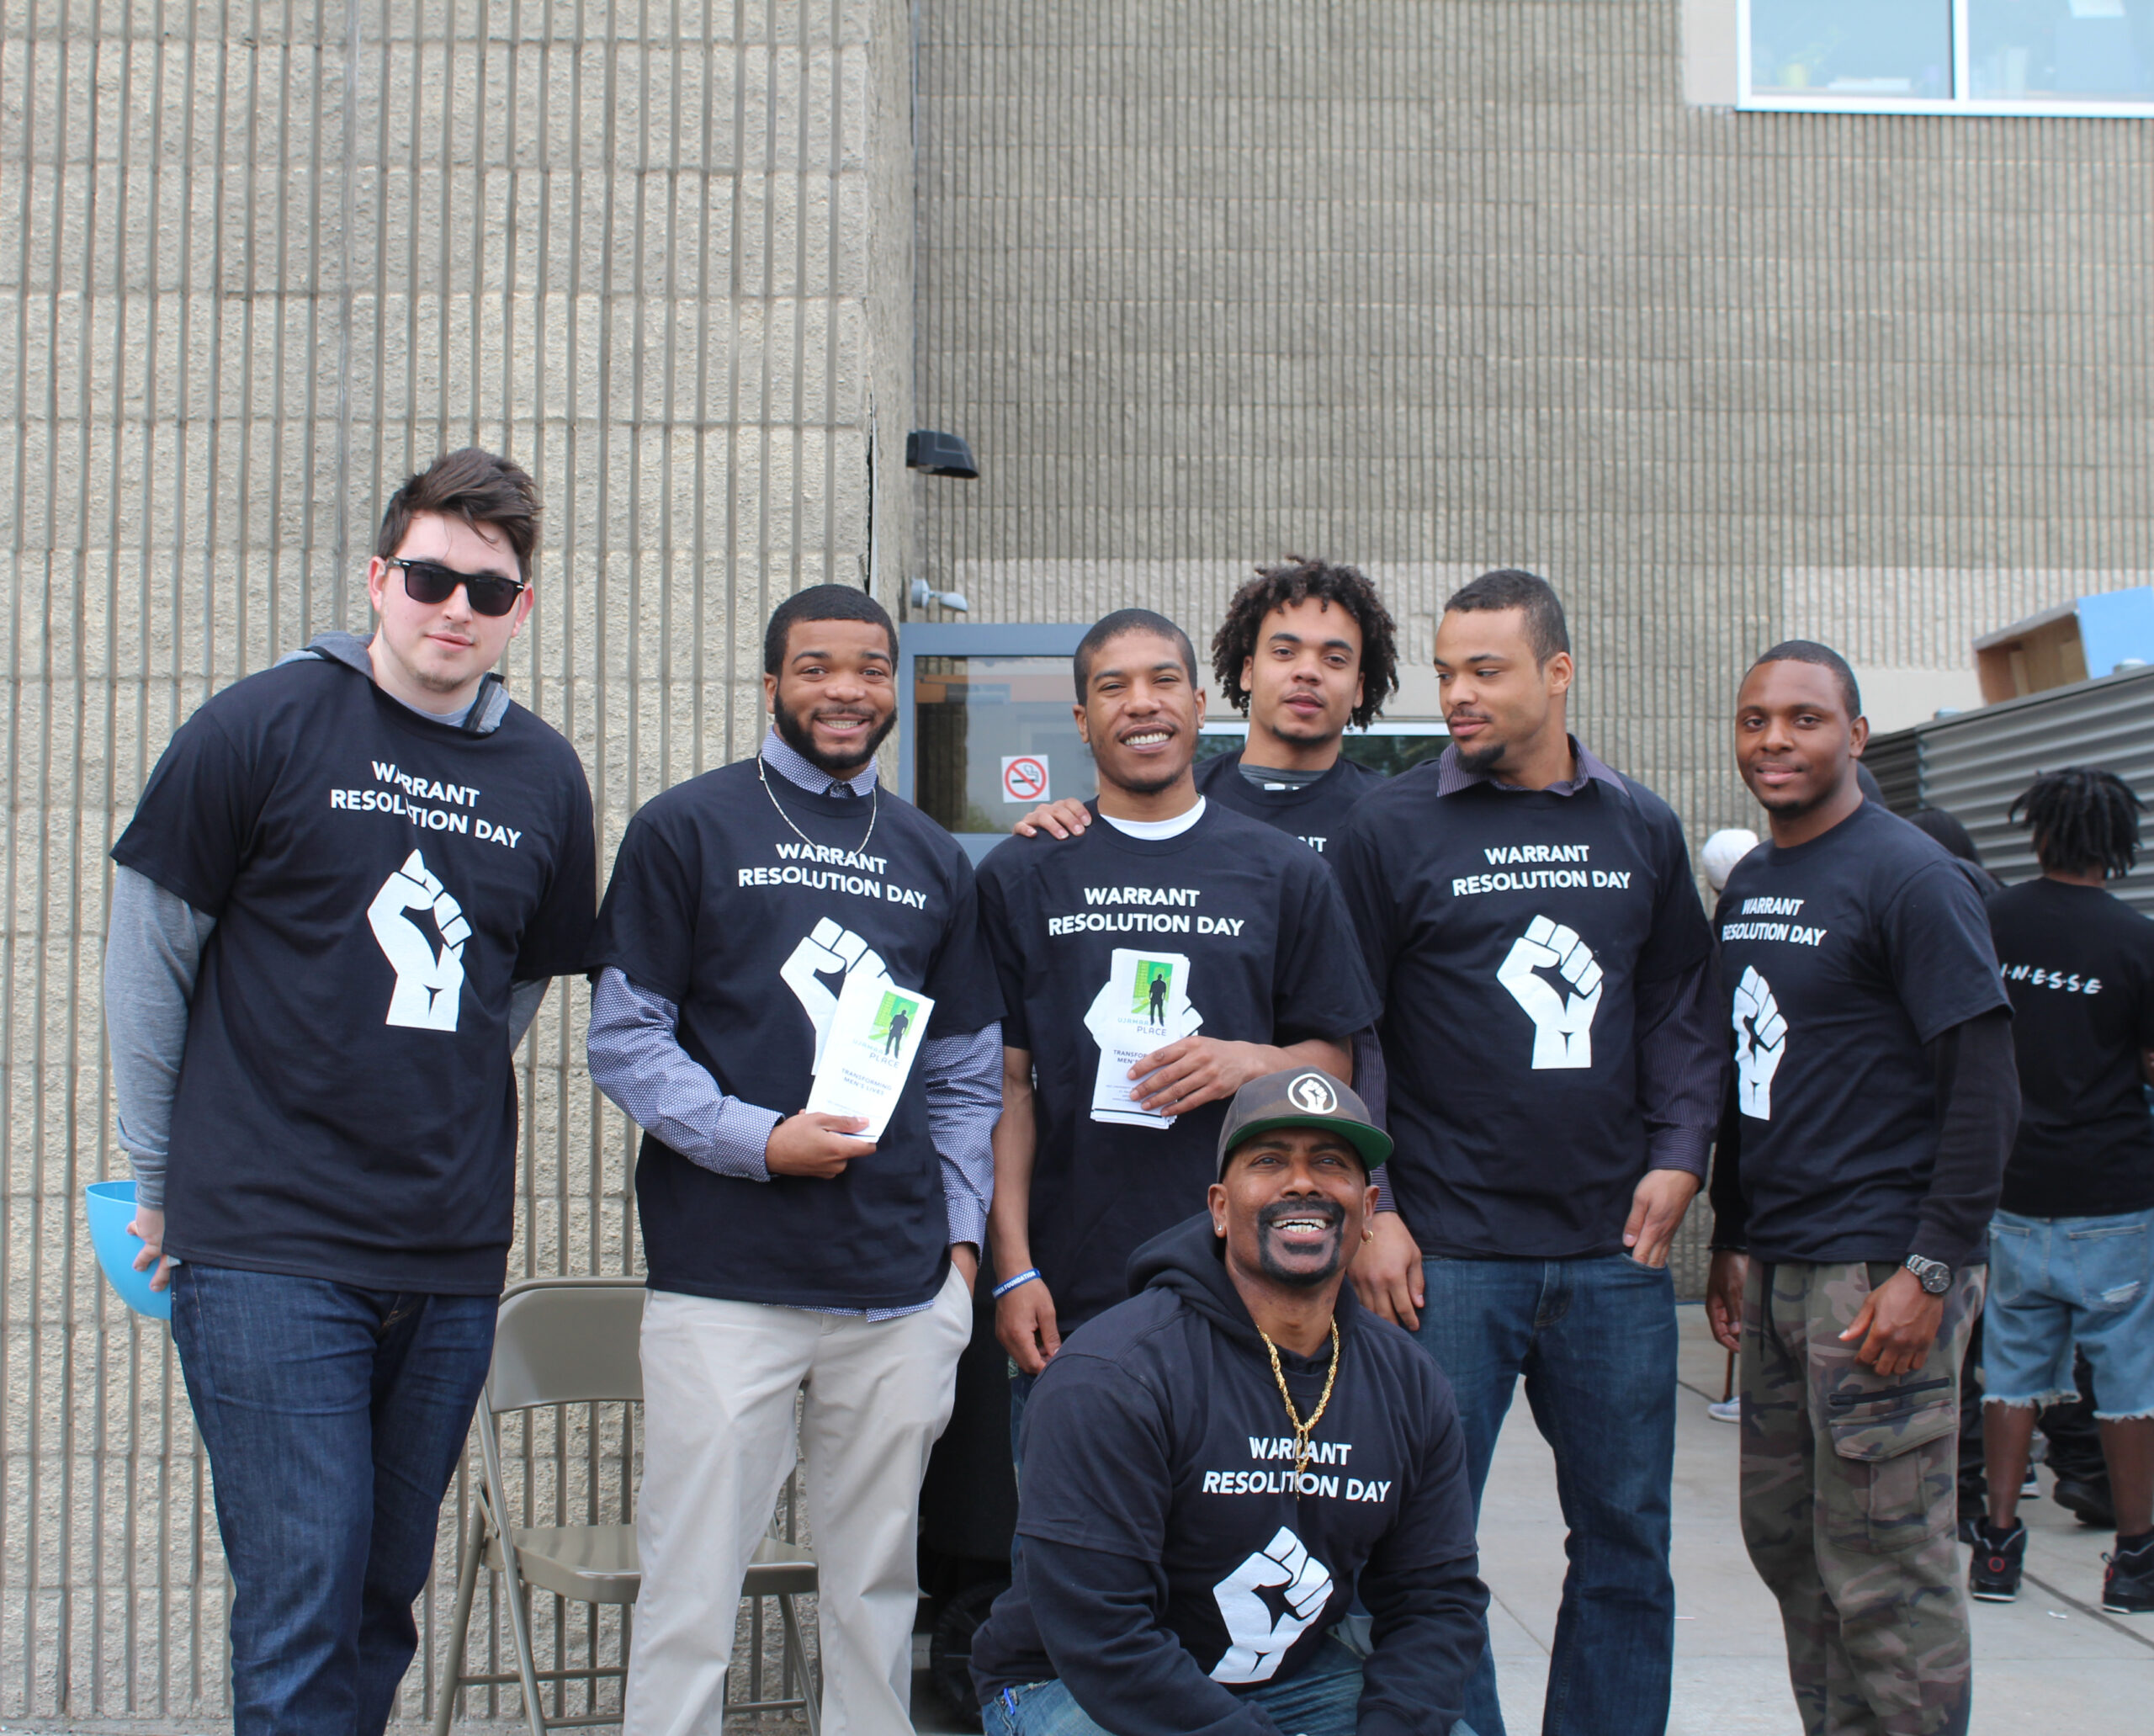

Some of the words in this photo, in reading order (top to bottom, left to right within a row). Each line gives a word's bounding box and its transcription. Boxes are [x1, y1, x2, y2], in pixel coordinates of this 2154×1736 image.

[371, 760, 480, 807] WARRANT
[330, 788, 468, 834] RESOLTION
[475, 819, 522, 848] DAY
[775, 843, 887, 874] WARRANT
[1484, 845, 1589, 865] WARRANT
[738, 866, 880, 899] RESOLUTION
[887, 884, 926, 910] DAY
[1452, 870, 1588, 896] RESOLUTION
[1592, 870, 1631, 889] DAY
[1084, 887, 1200, 907] WARRANT
[1741, 896, 1805, 916] WARRANT
[1048, 913, 1190, 936] RESOLUTION
[1197, 916, 1244, 937] DAY
[1722, 922, 1791, 942] RESOLUTION
[1789, 925, 1828, 947] DAY
[1137, 1026, 1167, 1036] PLACE
[869, 1052, 900, 1069] PLACE
[1113, 1049, 1147, 1059] TRANSFO
[842, 1068, 892, 1091] TRANSFORMING
[1004, 1271, 1036, 1290] FOUNDATION
[1202, 1470, 1340, 1498] RESOLTON
[1346, 1479, 1391, 1502] DAY
